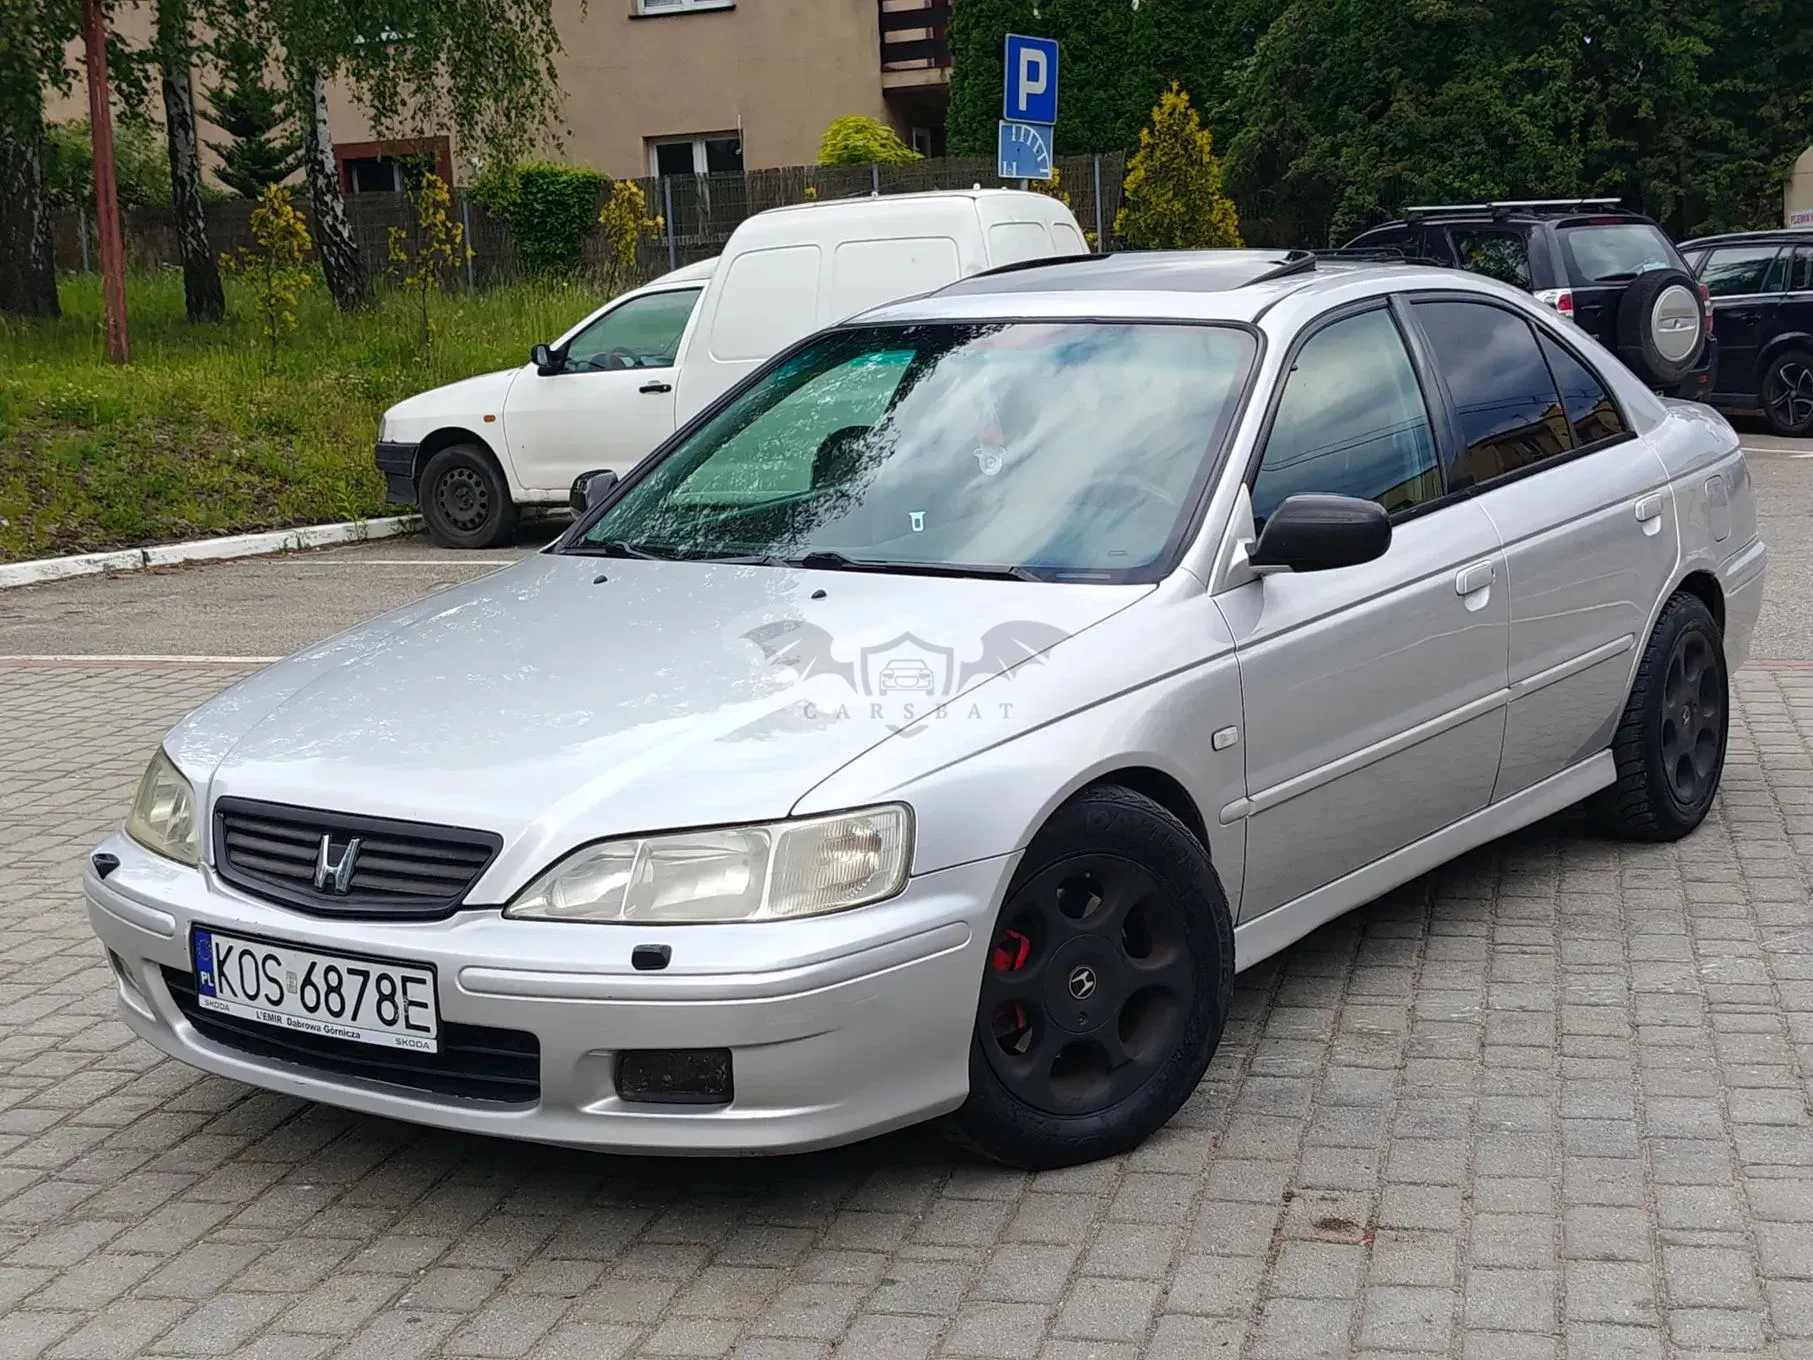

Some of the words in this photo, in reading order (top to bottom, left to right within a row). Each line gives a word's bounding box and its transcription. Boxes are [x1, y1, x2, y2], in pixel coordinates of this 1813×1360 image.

[1018, 47, 1047, 111] P
[200, 971, 214, 987] PL
[215, 941, 285, 1007] KOS
[300, 961, 431, 1033] 6878E
[256, 1010, 282, 1024] L'EMIR
[395, 1037, 430, 1050] SKODA
